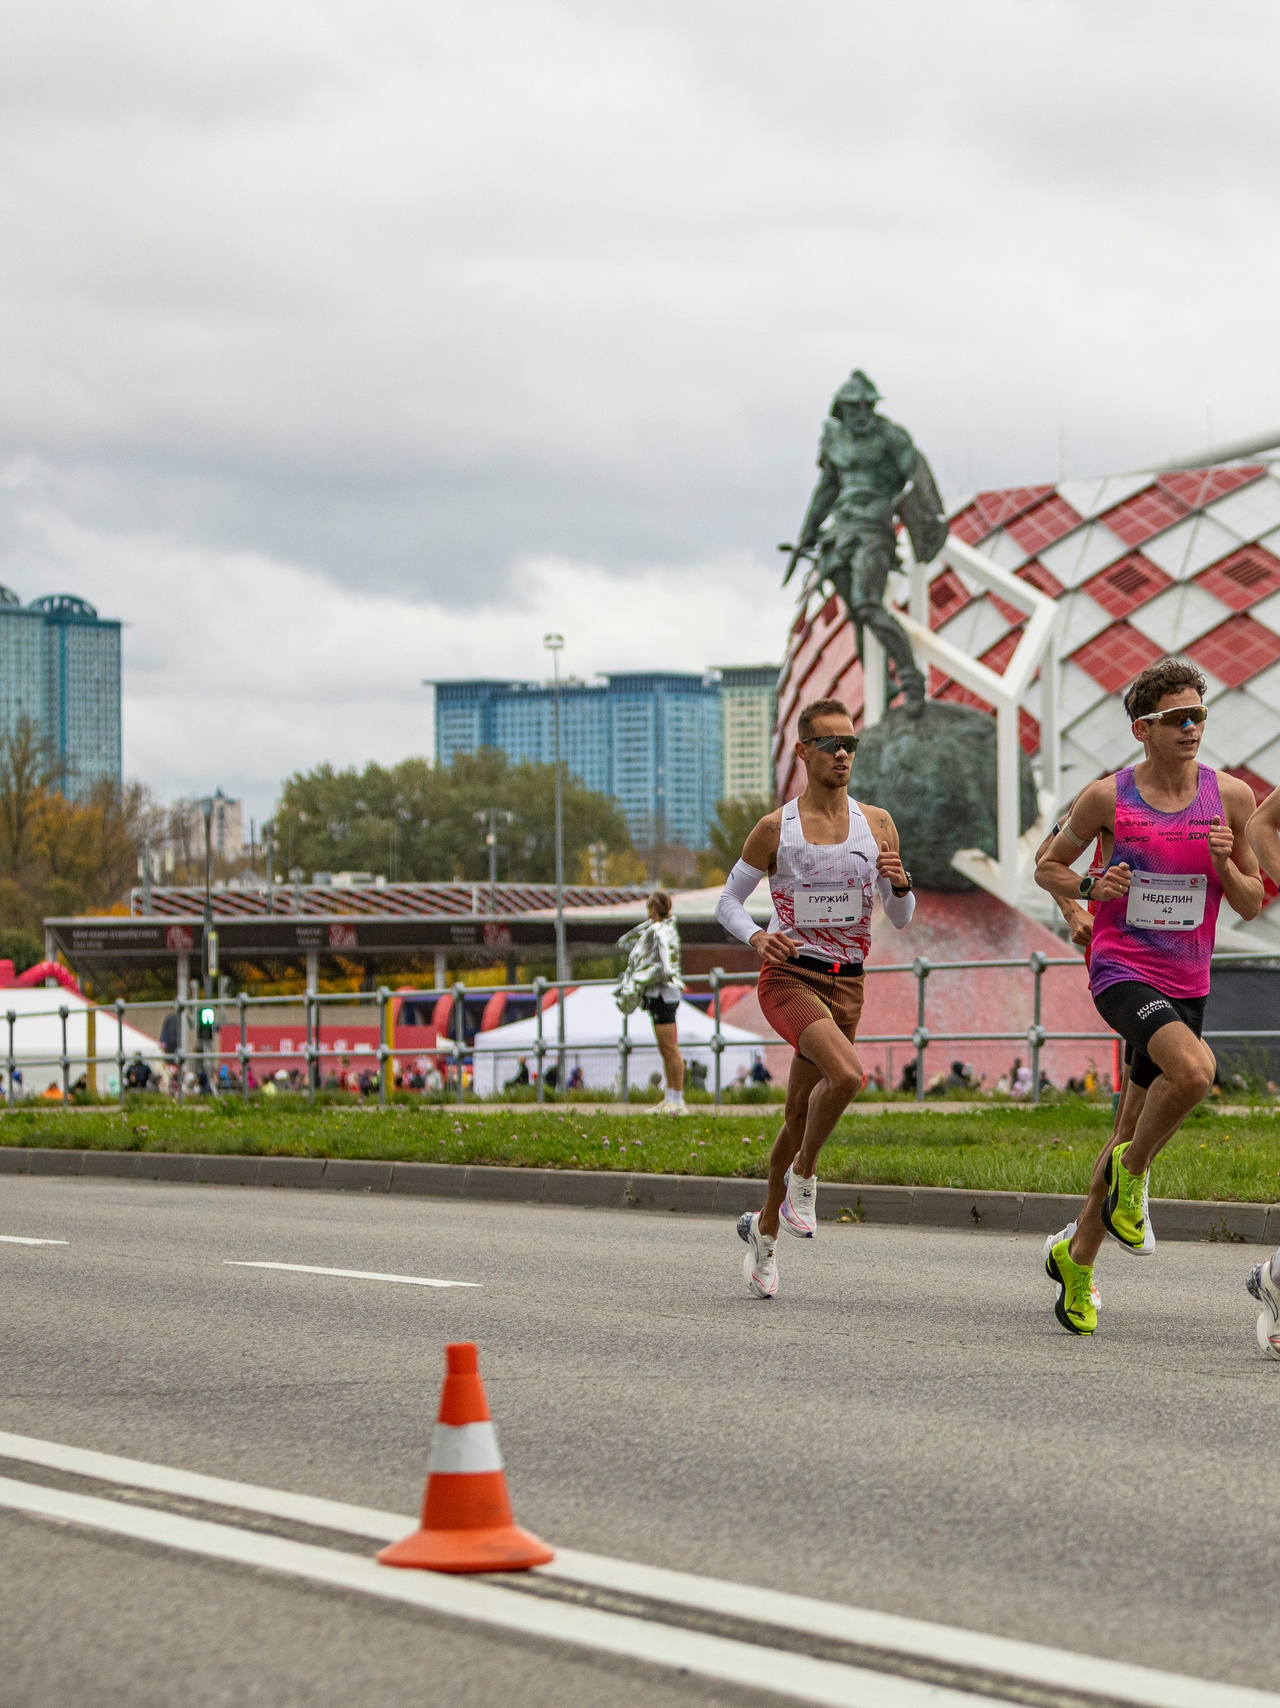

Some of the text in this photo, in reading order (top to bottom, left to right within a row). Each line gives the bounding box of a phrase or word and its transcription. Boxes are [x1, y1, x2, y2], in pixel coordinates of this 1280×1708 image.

[1186, 832, 1210, 841] SON
[808, 893, 849, 903] ГУРЖИЙ
[1142, 893, 1193, 905] НЕДЕЛИН
